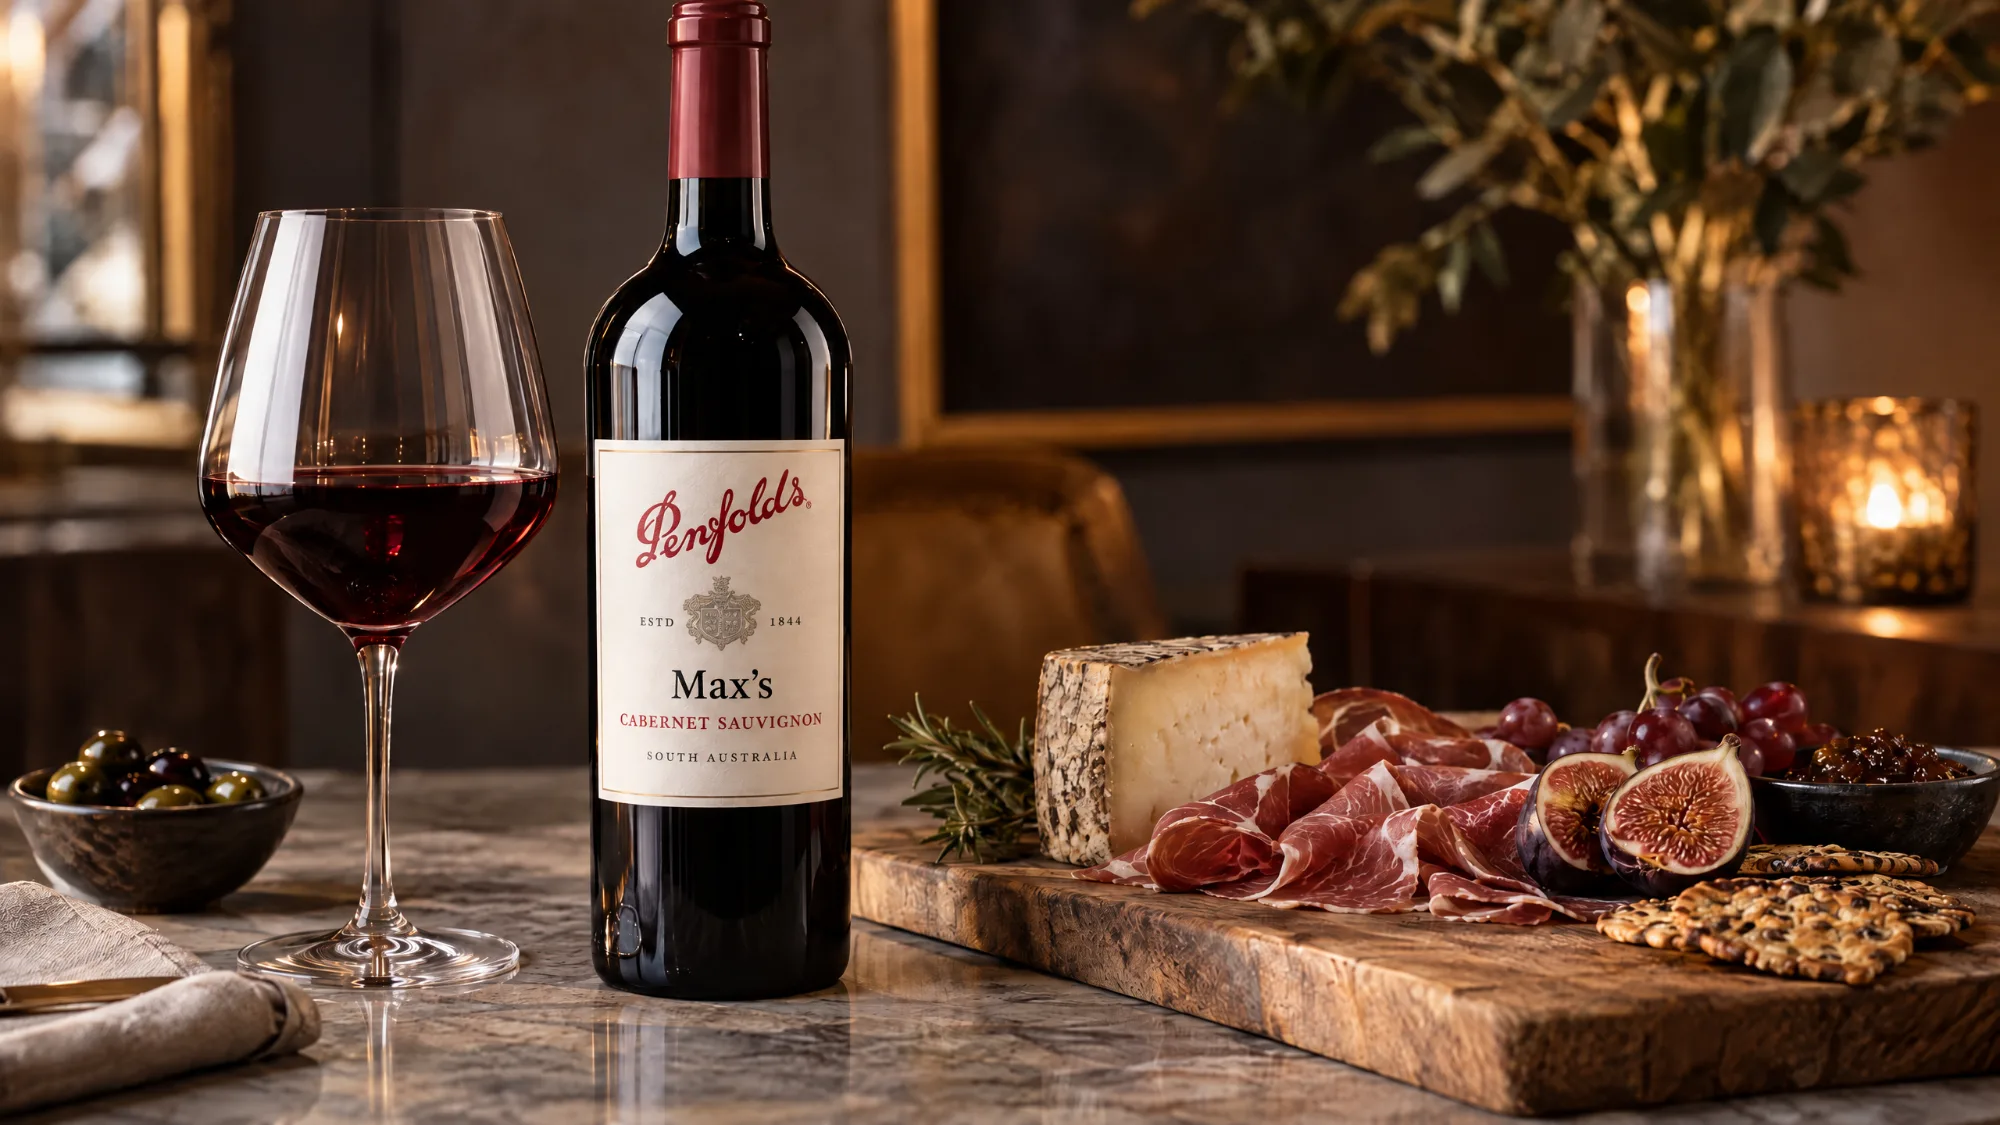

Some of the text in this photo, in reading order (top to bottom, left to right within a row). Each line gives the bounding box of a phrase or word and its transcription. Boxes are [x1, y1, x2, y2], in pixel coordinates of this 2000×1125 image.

[635, 468, 807, 568] Penfolds
[640, 615, 802, 628] ESTD 1844
[620, 712, 823, 730] CABERNET SAUVIGNON
[647, 750, 798, 763] SOUTH AUSTRALIA
